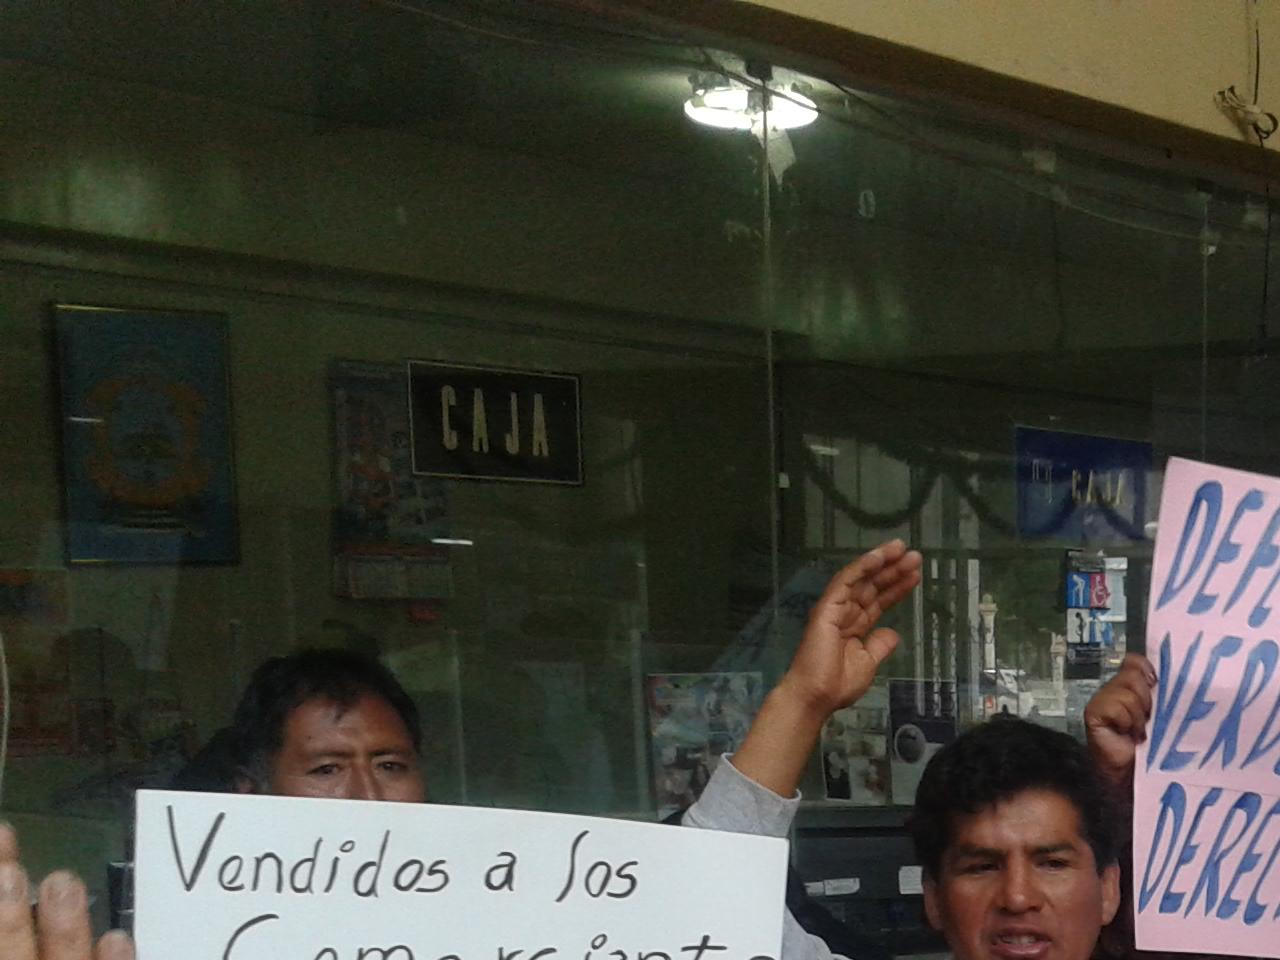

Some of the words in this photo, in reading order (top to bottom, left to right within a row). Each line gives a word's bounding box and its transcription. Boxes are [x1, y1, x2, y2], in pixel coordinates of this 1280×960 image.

[440, 385, 549, 458] CAJA
[166, 805, 450, 899] Vendidos
[484, 851, 516, 893] a
